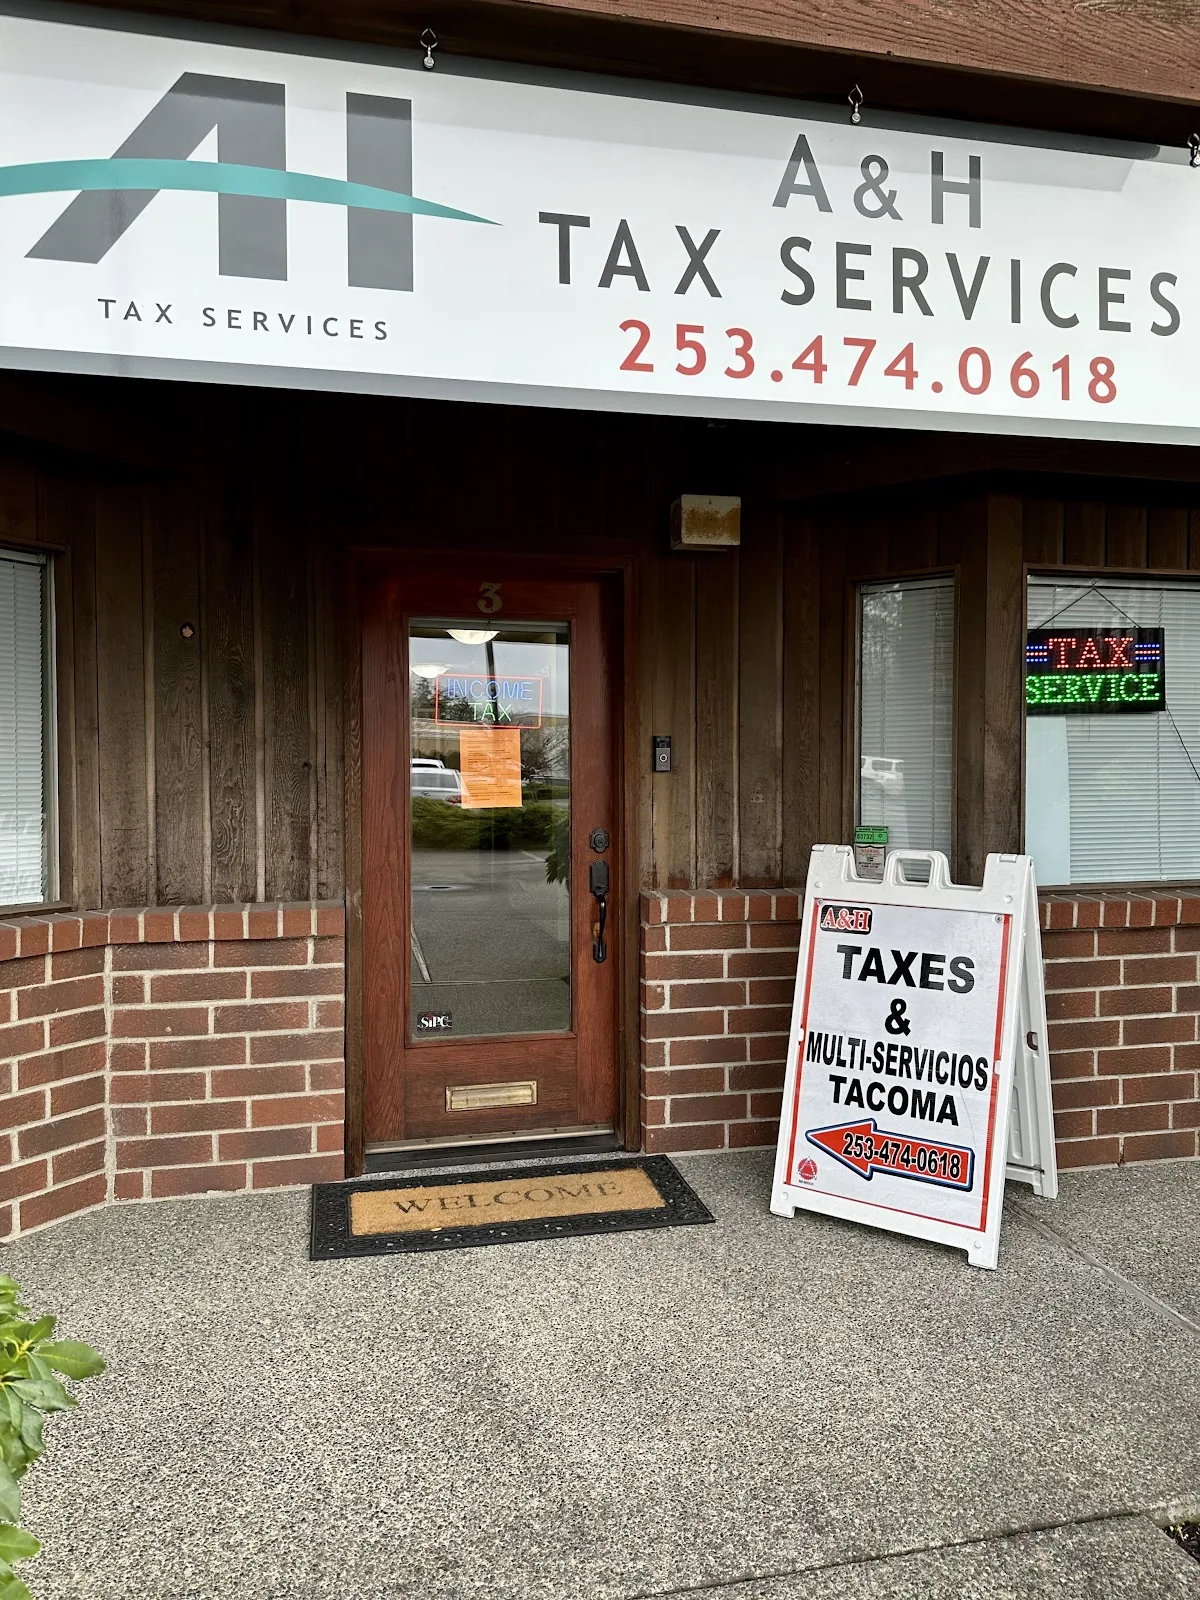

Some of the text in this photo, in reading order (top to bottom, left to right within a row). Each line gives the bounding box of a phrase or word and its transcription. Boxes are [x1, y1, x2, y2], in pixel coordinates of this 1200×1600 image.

[539, 211, 1181, 337] TAX SERVICES
[97, 297, 389, 341] TAX SERVICES
[618, 319, 1118, 403] 253.474.0618
[476, 581, 503, 614] 3
[1049, 637, 1134, 669] TAX
[446, 678, 533, 701] INCOME
[1026, 673, 1161, 704] SERVICE
[467, 702, 512, 722] TAX
[821, 907, 871, 932] A&H
[836, 944, 975, 994] TAXES
[884, 998, 911, 1037] &
[806, 1030, 989, 1092] MULTI-SERVICIOS
[828, 1073, 959, 1127] TACOMA
[842, 1131, 962, 1179] 253-474-0618
[393, 1182, 623, 1214] WELCOME
